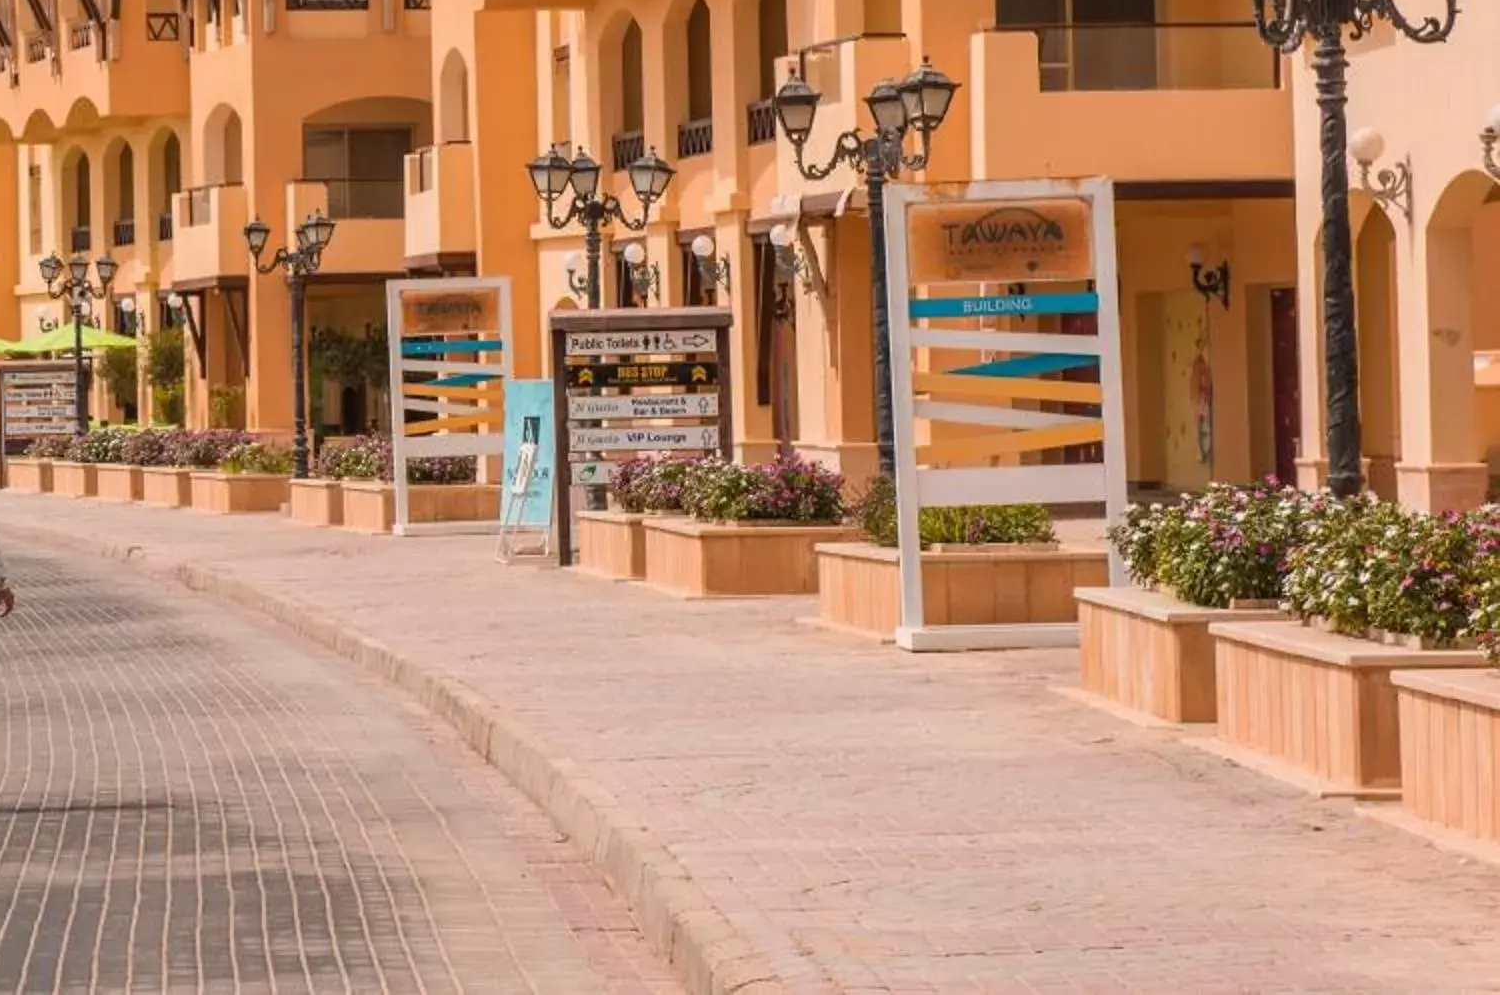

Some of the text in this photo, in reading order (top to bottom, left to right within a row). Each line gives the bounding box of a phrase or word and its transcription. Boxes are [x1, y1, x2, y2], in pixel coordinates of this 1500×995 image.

[941, 219, 1064, 245] TAWAYA
[963, 298, 1033, 314] BUILDING
[571, 337, 639, 350] Public Toilets
[626, 432, 687, 444] VIP Lounge
